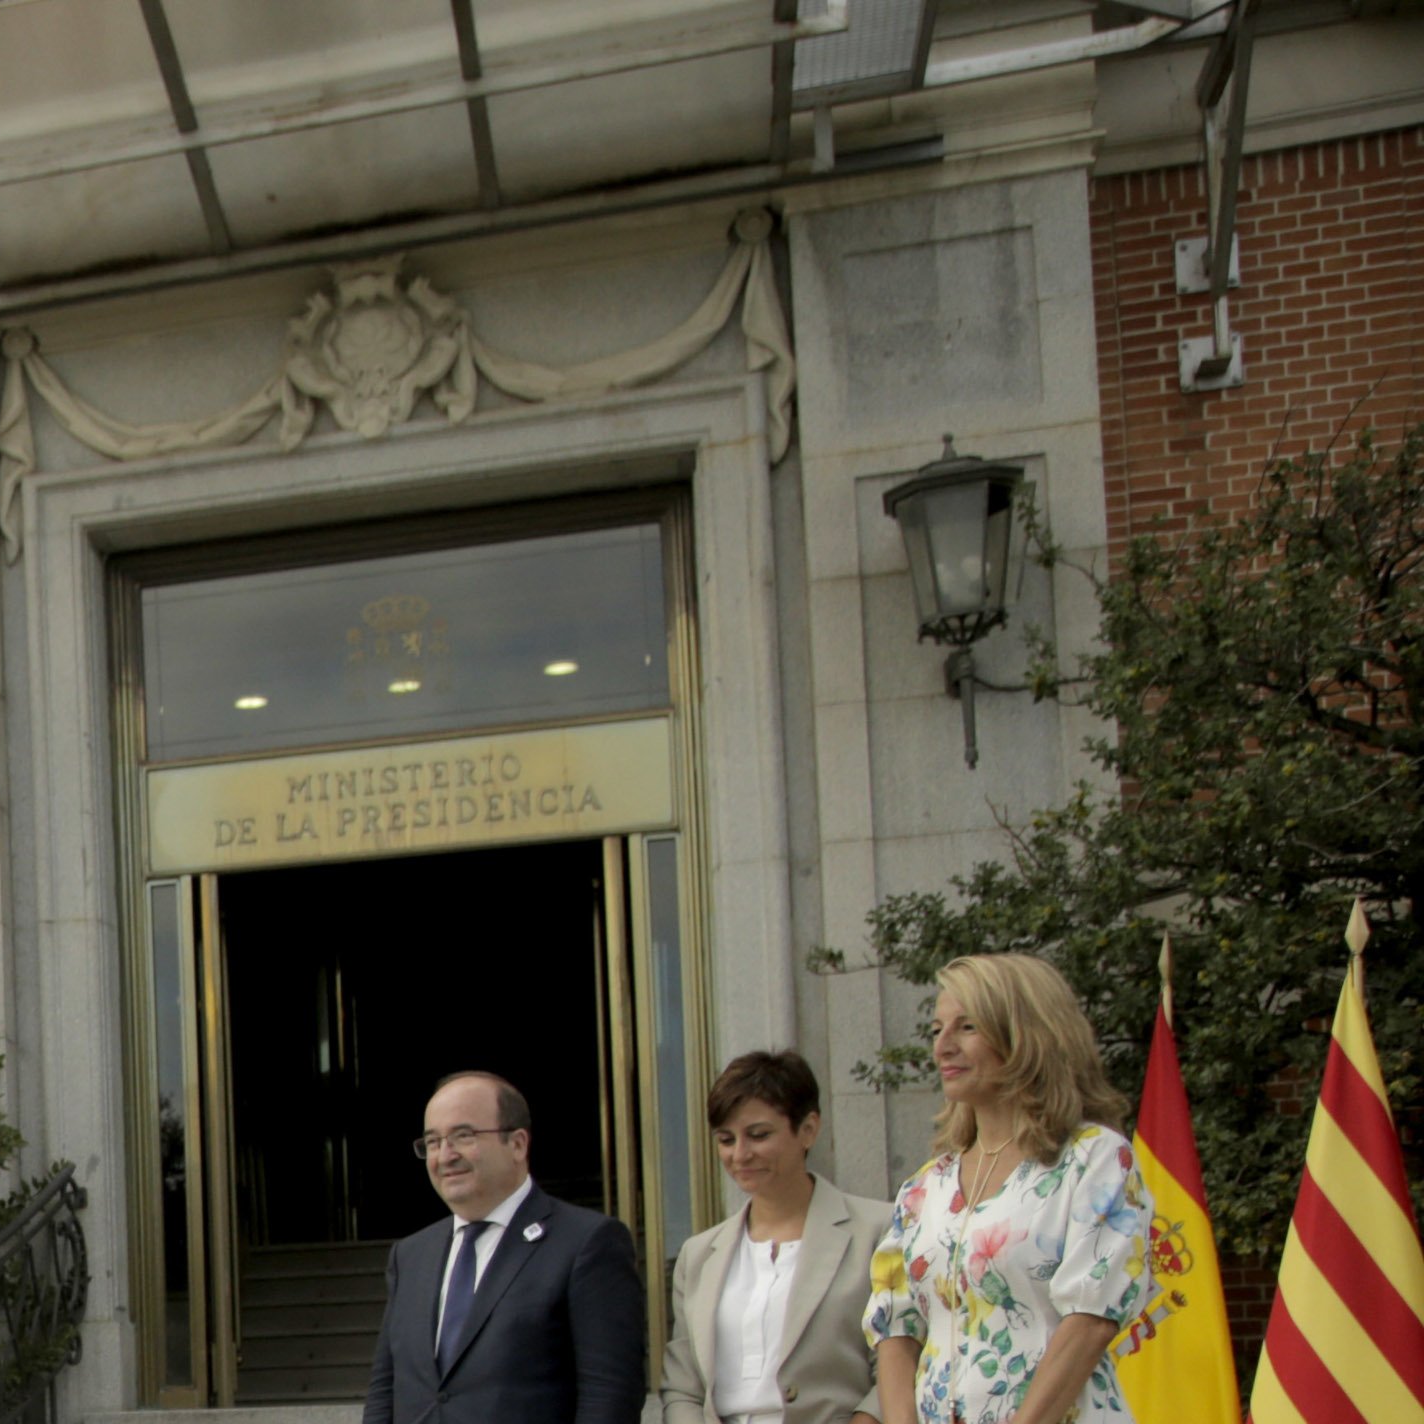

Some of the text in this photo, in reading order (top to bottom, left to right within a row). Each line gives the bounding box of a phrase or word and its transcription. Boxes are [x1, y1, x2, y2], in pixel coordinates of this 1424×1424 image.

[287, 753, 522, 804] MINISTERIO
[214, 785, 603, 848] DE LA PRESIDENCIA
